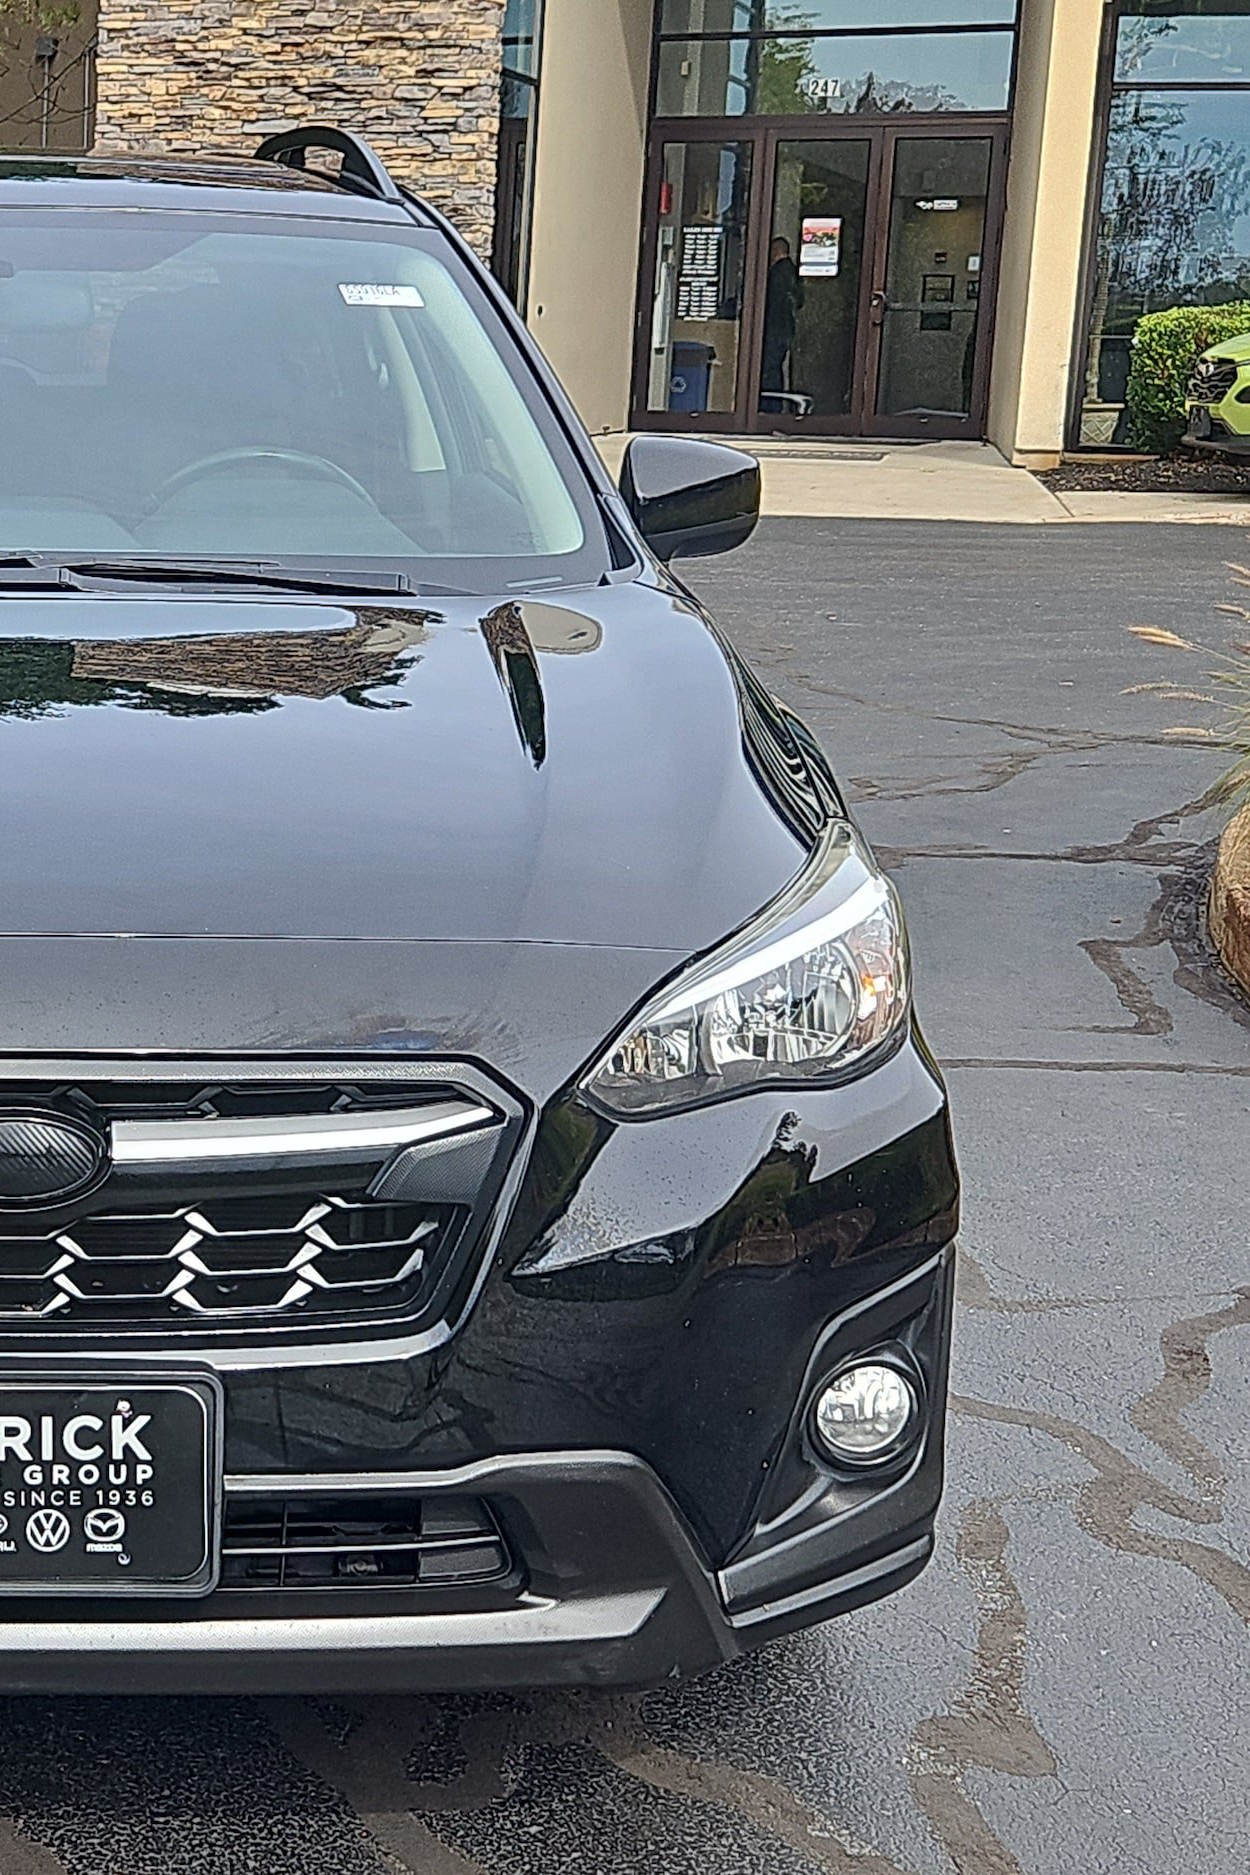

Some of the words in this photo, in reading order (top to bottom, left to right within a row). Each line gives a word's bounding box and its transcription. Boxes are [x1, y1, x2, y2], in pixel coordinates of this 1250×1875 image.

[810, 79, 839, 96] 247
[23, 1463, 153, 1486] GROUP
[3, 1490, 82, 1507] SINCE
[96, 1489, 154, 1506] 1936
